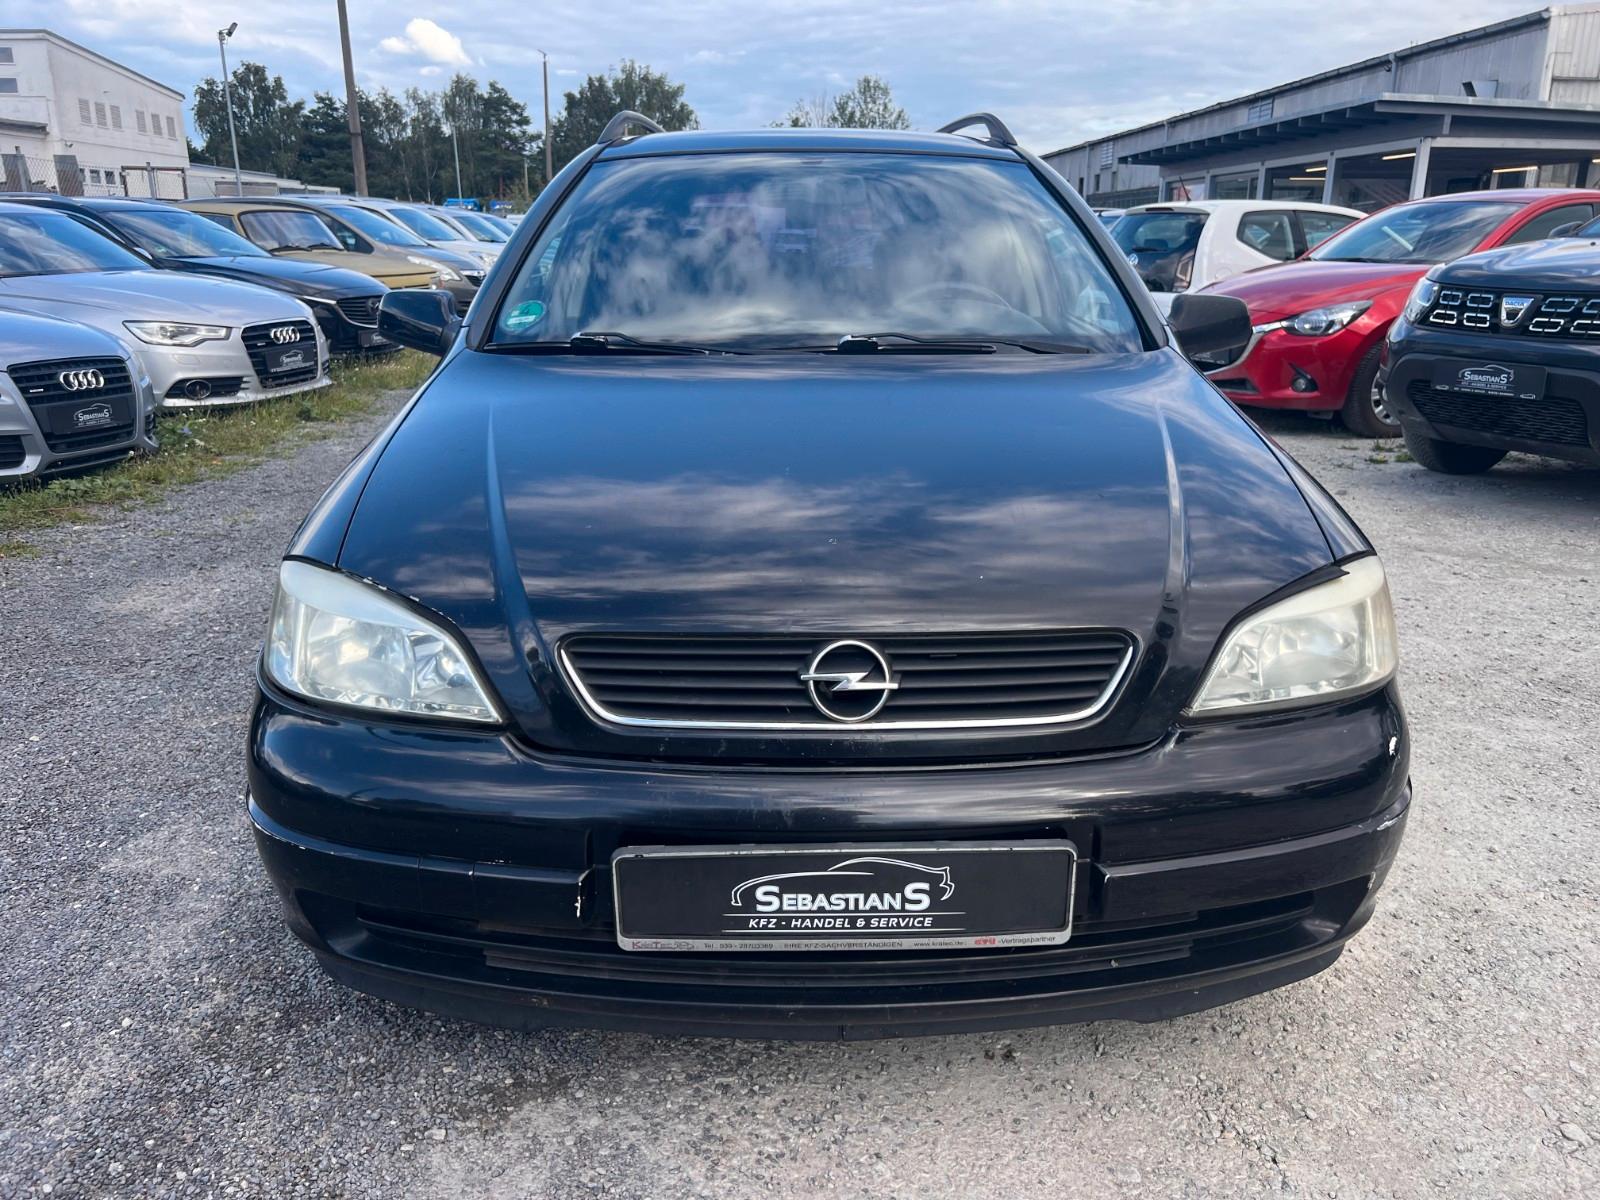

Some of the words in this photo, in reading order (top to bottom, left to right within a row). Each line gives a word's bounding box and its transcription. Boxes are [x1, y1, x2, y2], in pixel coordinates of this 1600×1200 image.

[1464, 371, 1508, 384] SEBASTIANS
[755, 881, 931, 913] SEBASTIANS
[749, 918, 777, 928] KFZ
[791, 918, 851, 928] HANDEL
[856, 917, 866, 928] &
[870, 917, 934, 928] SERVICE
